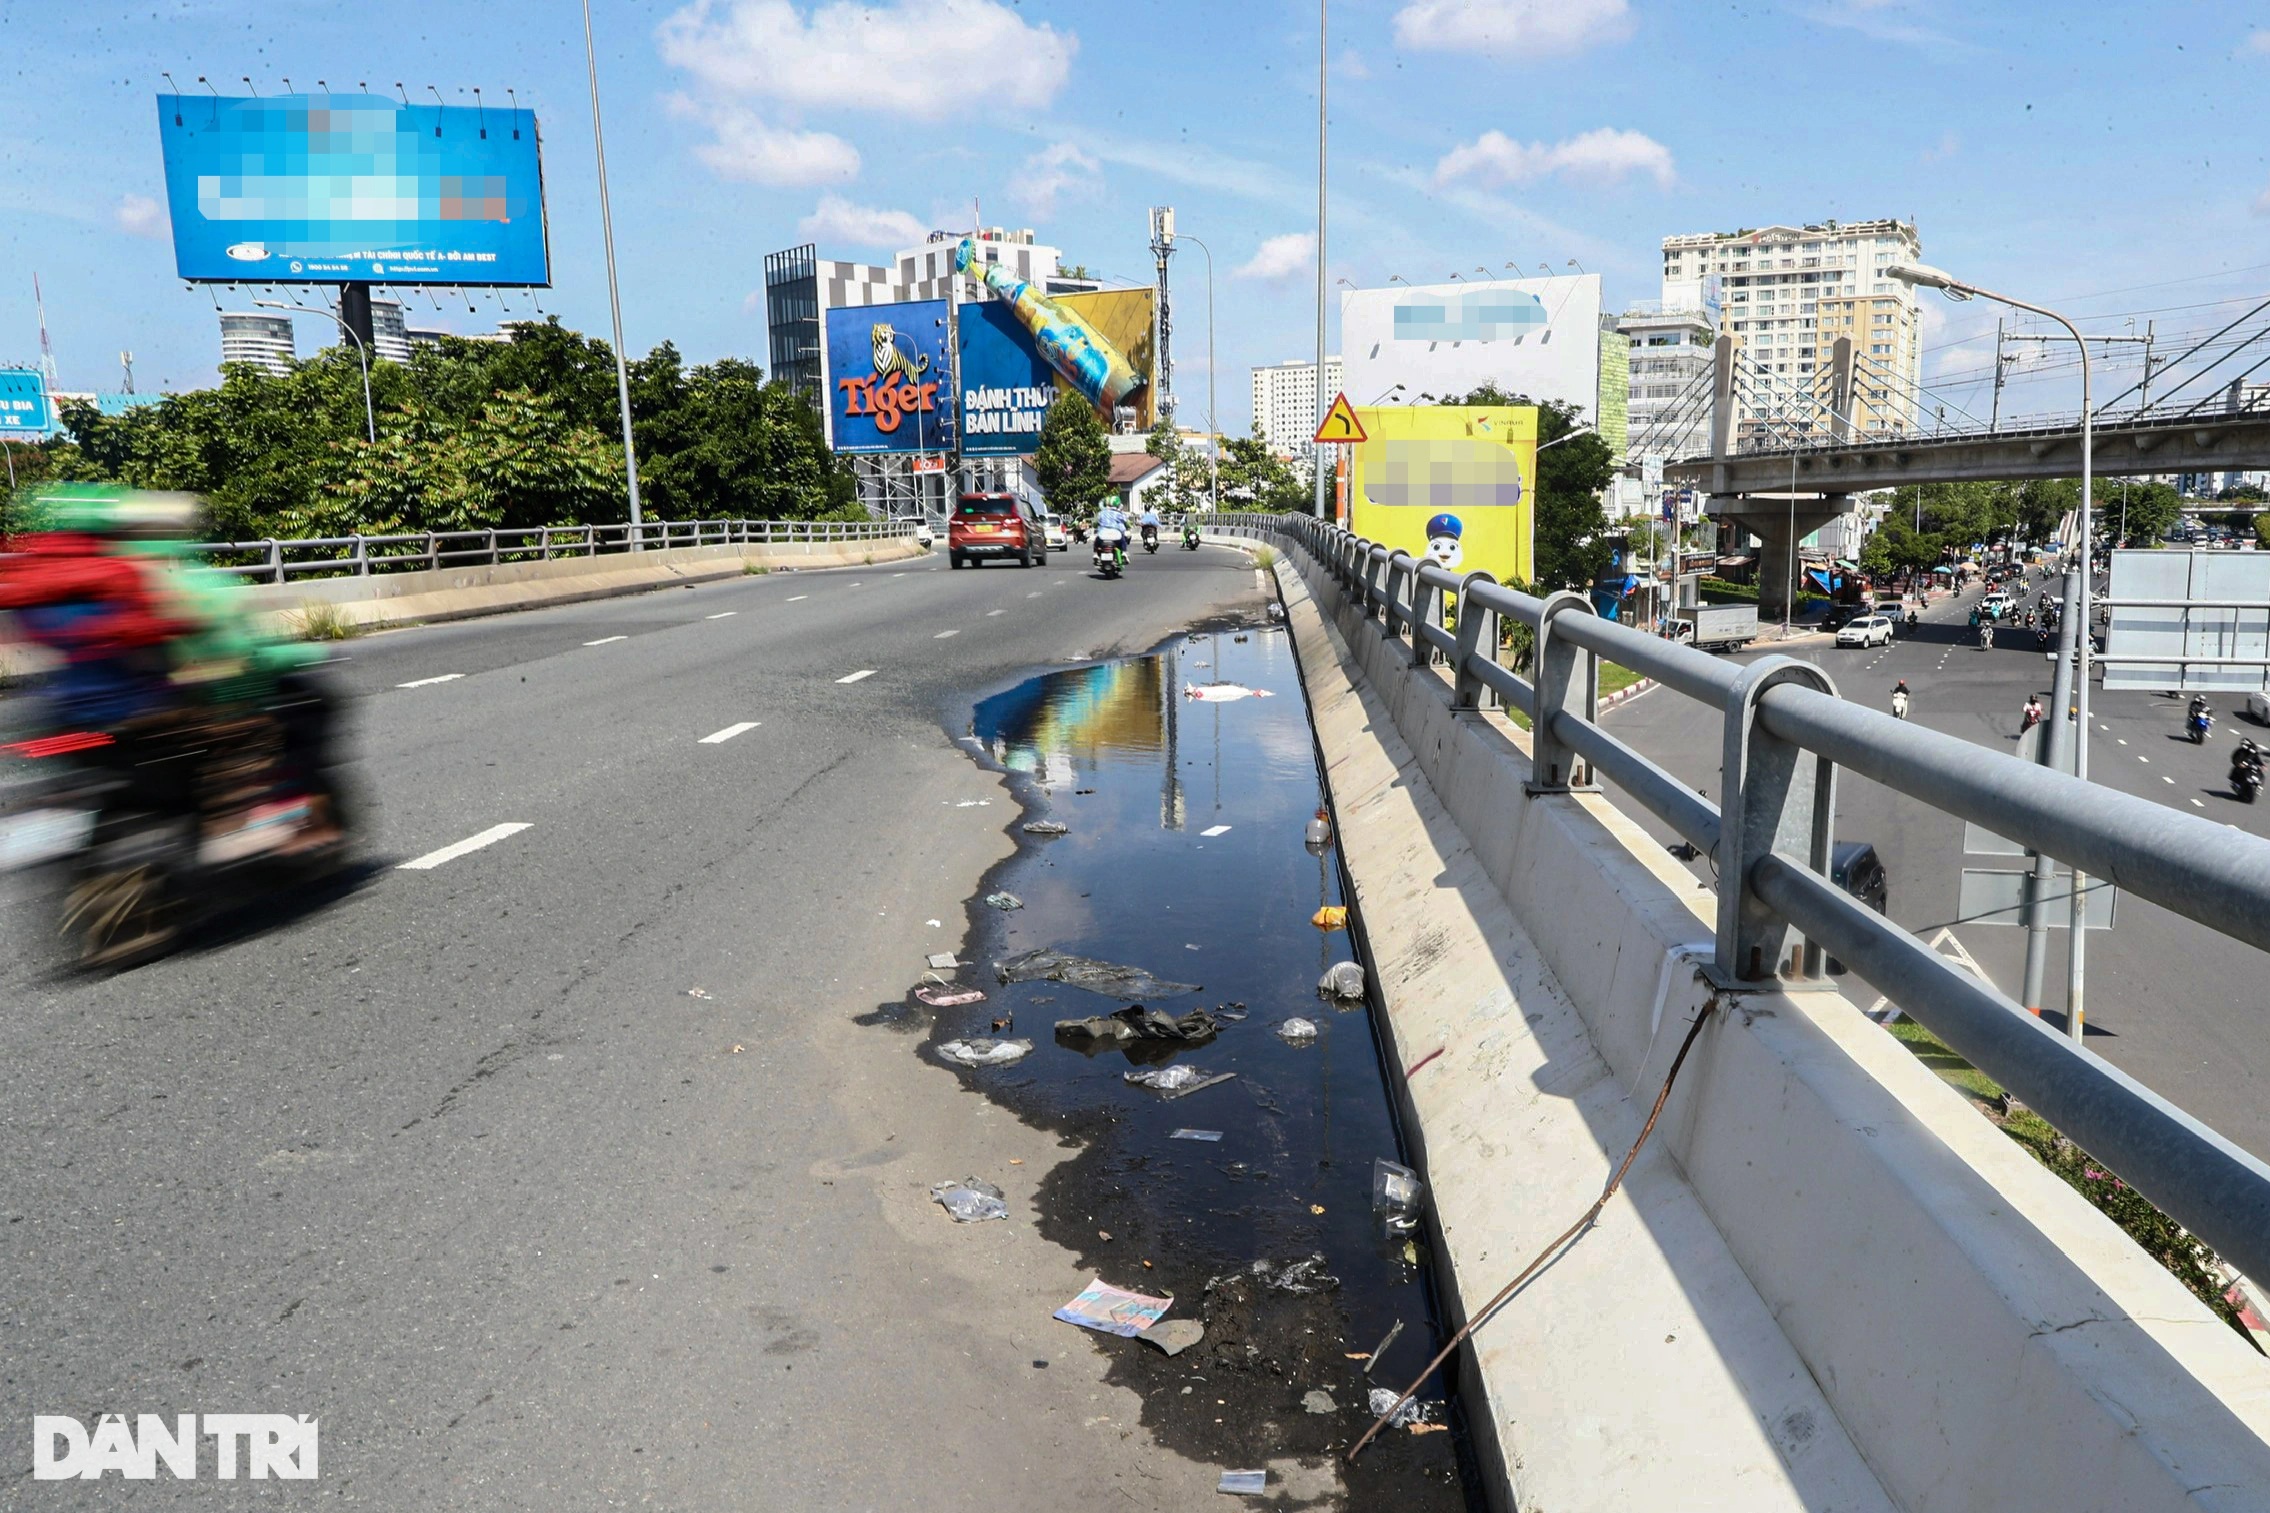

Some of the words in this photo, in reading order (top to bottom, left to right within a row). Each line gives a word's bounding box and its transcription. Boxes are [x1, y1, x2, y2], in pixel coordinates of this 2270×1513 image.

[476, 253, 497, 262] BEST
[839, 370, 938, 432] Tiger
[965, 384, 1012, 410] ĐÁNH
[1013, 382, 1060, 408] THỨC
[12, 400, 34, 411] BIA
[4, 415, 21, 425] XE
[1002, 407, 1042, 433] LĨNH
